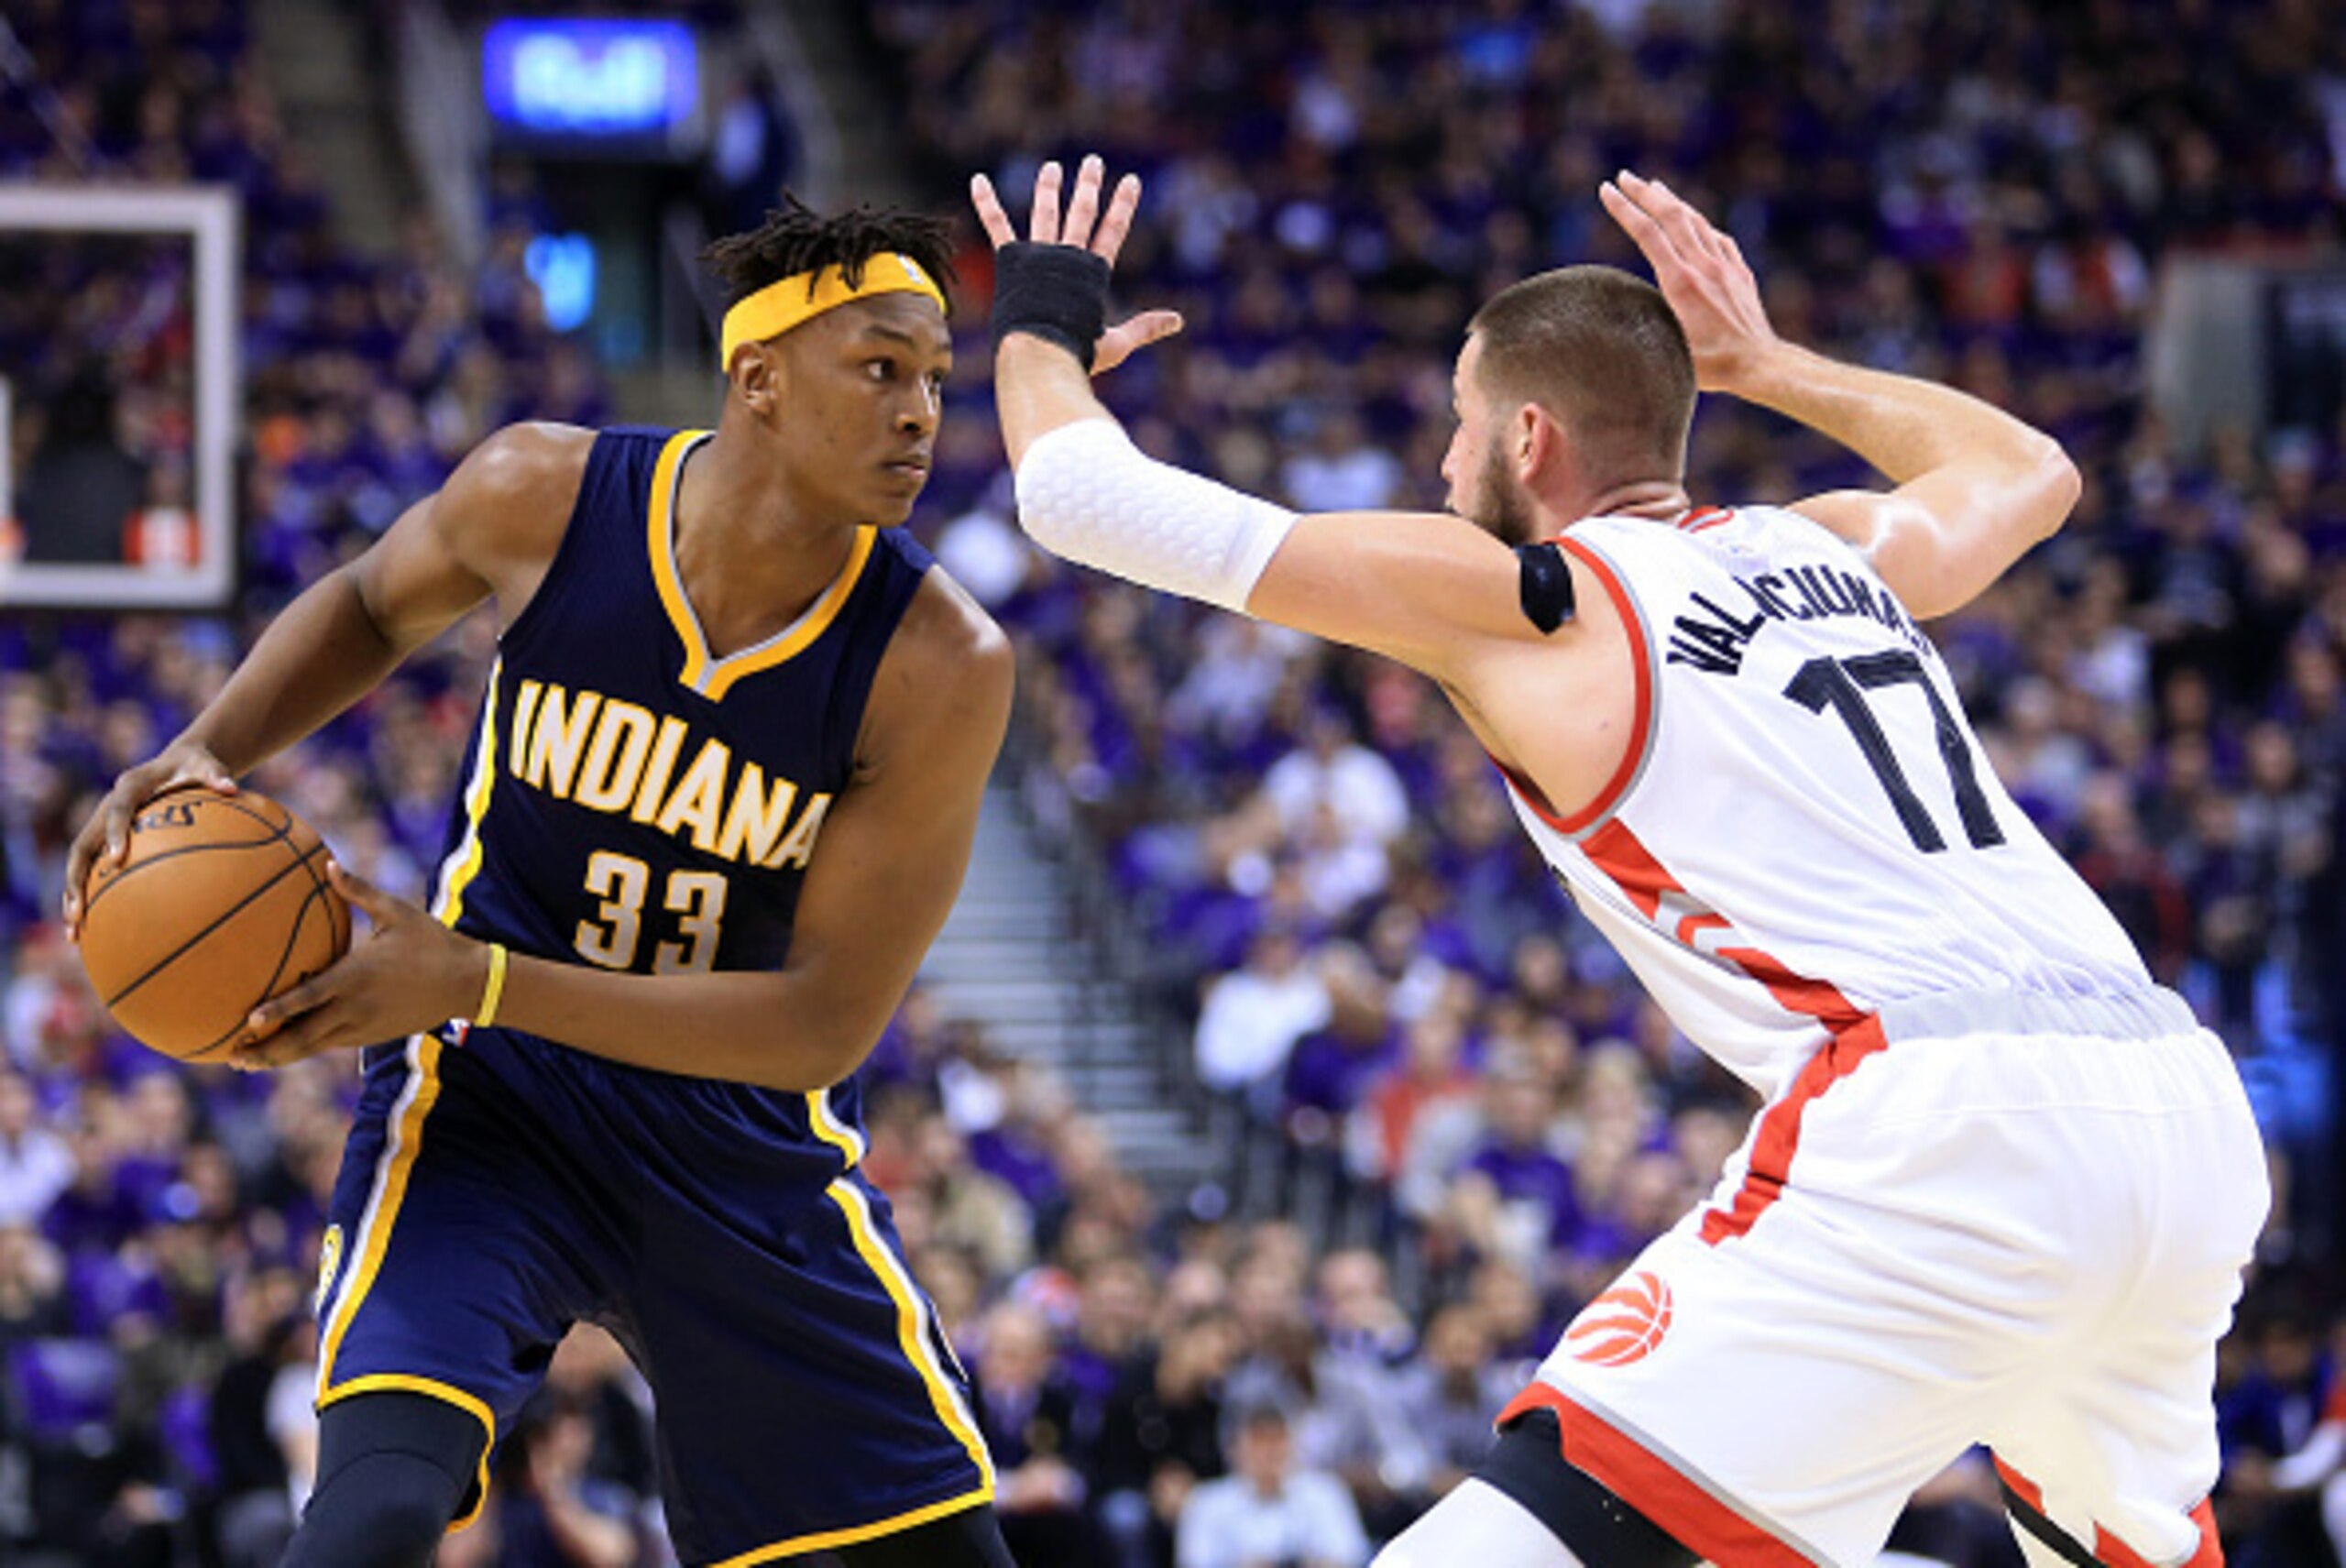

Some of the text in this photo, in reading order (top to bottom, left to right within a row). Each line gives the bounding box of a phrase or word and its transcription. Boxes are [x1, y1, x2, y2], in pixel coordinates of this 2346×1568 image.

[510, 679, 832, 870] INDIANA
[1781, 648, 2007, 853] 17
[575, 849, 729, 975] 33
